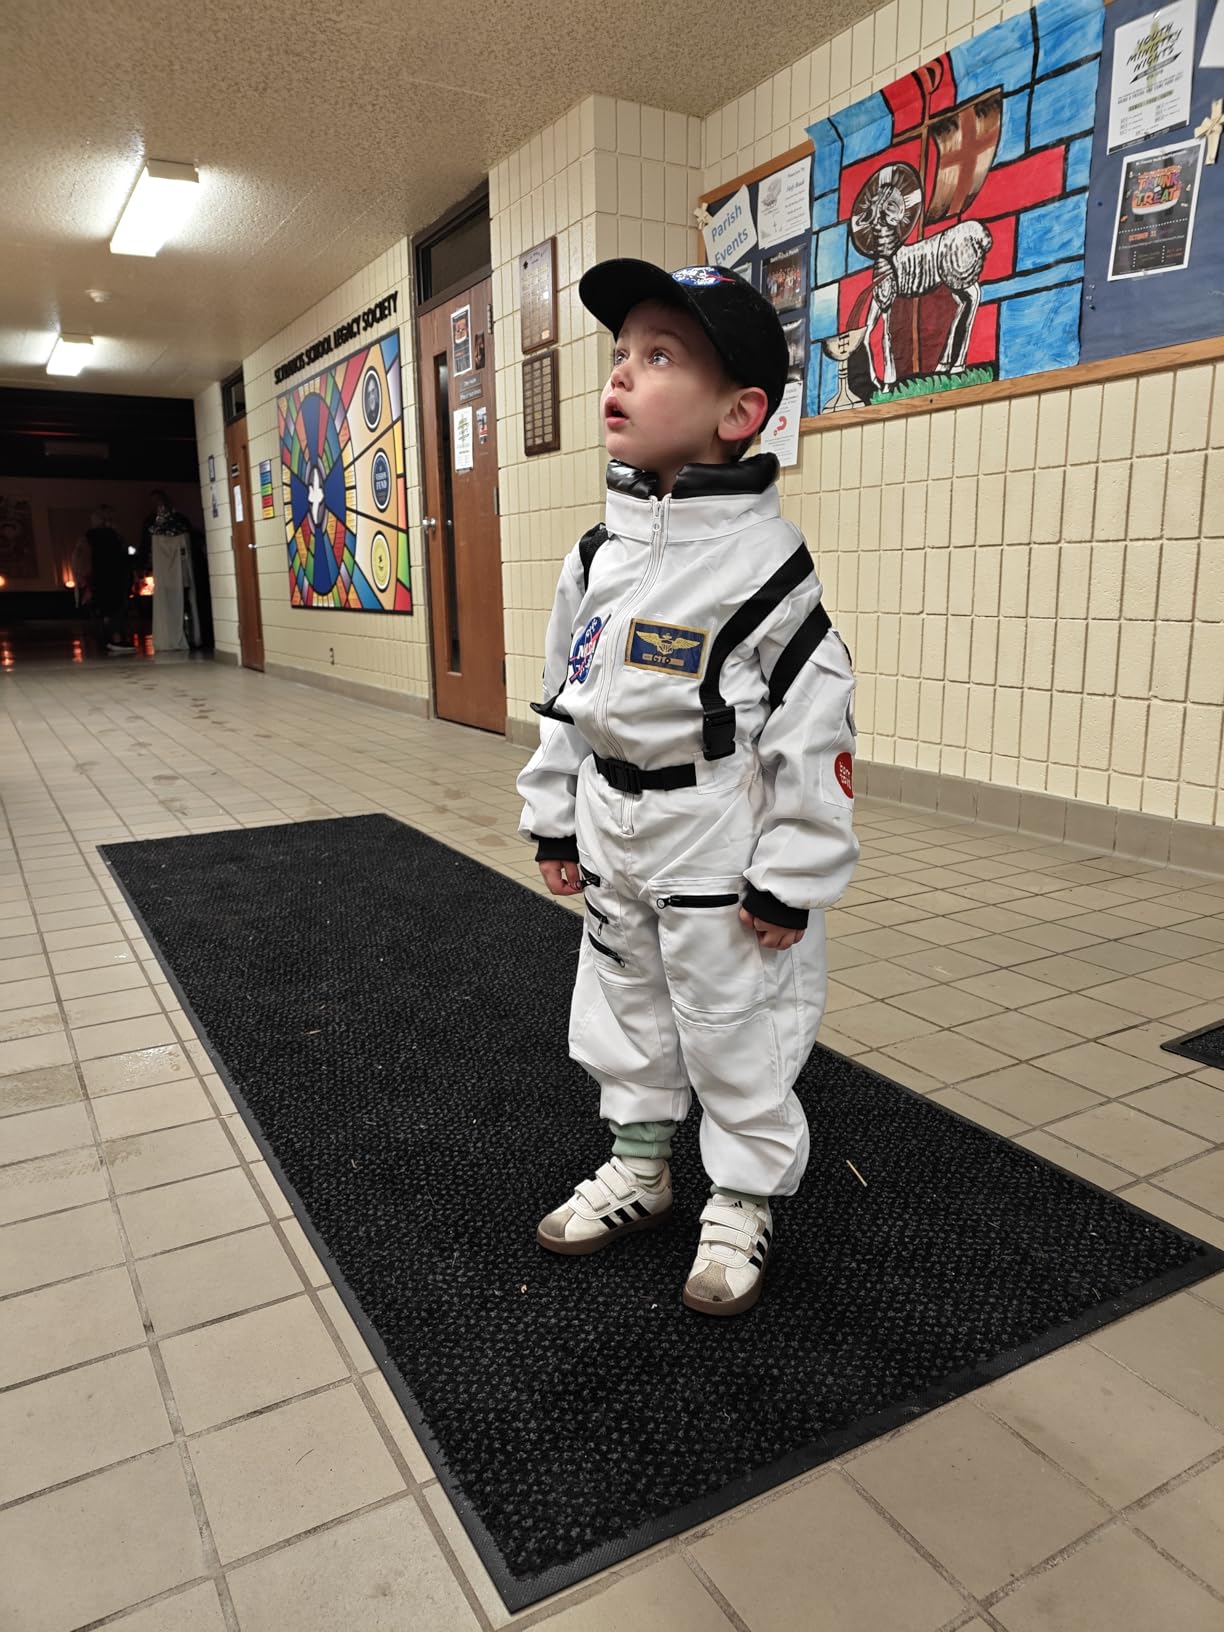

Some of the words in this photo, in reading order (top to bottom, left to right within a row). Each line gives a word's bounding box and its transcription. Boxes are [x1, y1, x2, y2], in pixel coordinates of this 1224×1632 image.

[1126, 27, 1183, 66] MINISTRY
[1136, 21, 1174, 50] YOUTH
[1133, 43, 1175, 73] NIGHTS
[1134, 186, 1177, 207] TREAT
[1137, 171, 1181, 192] TRUNK
[711, 204, 742, 242] Parish
[714, 227, 749, 266] Events
[305, 334, 334, 366] SCHOOL
[333, 314, 361, 350] LEGACY
[362, 290, 399, 332] SOCIETY
